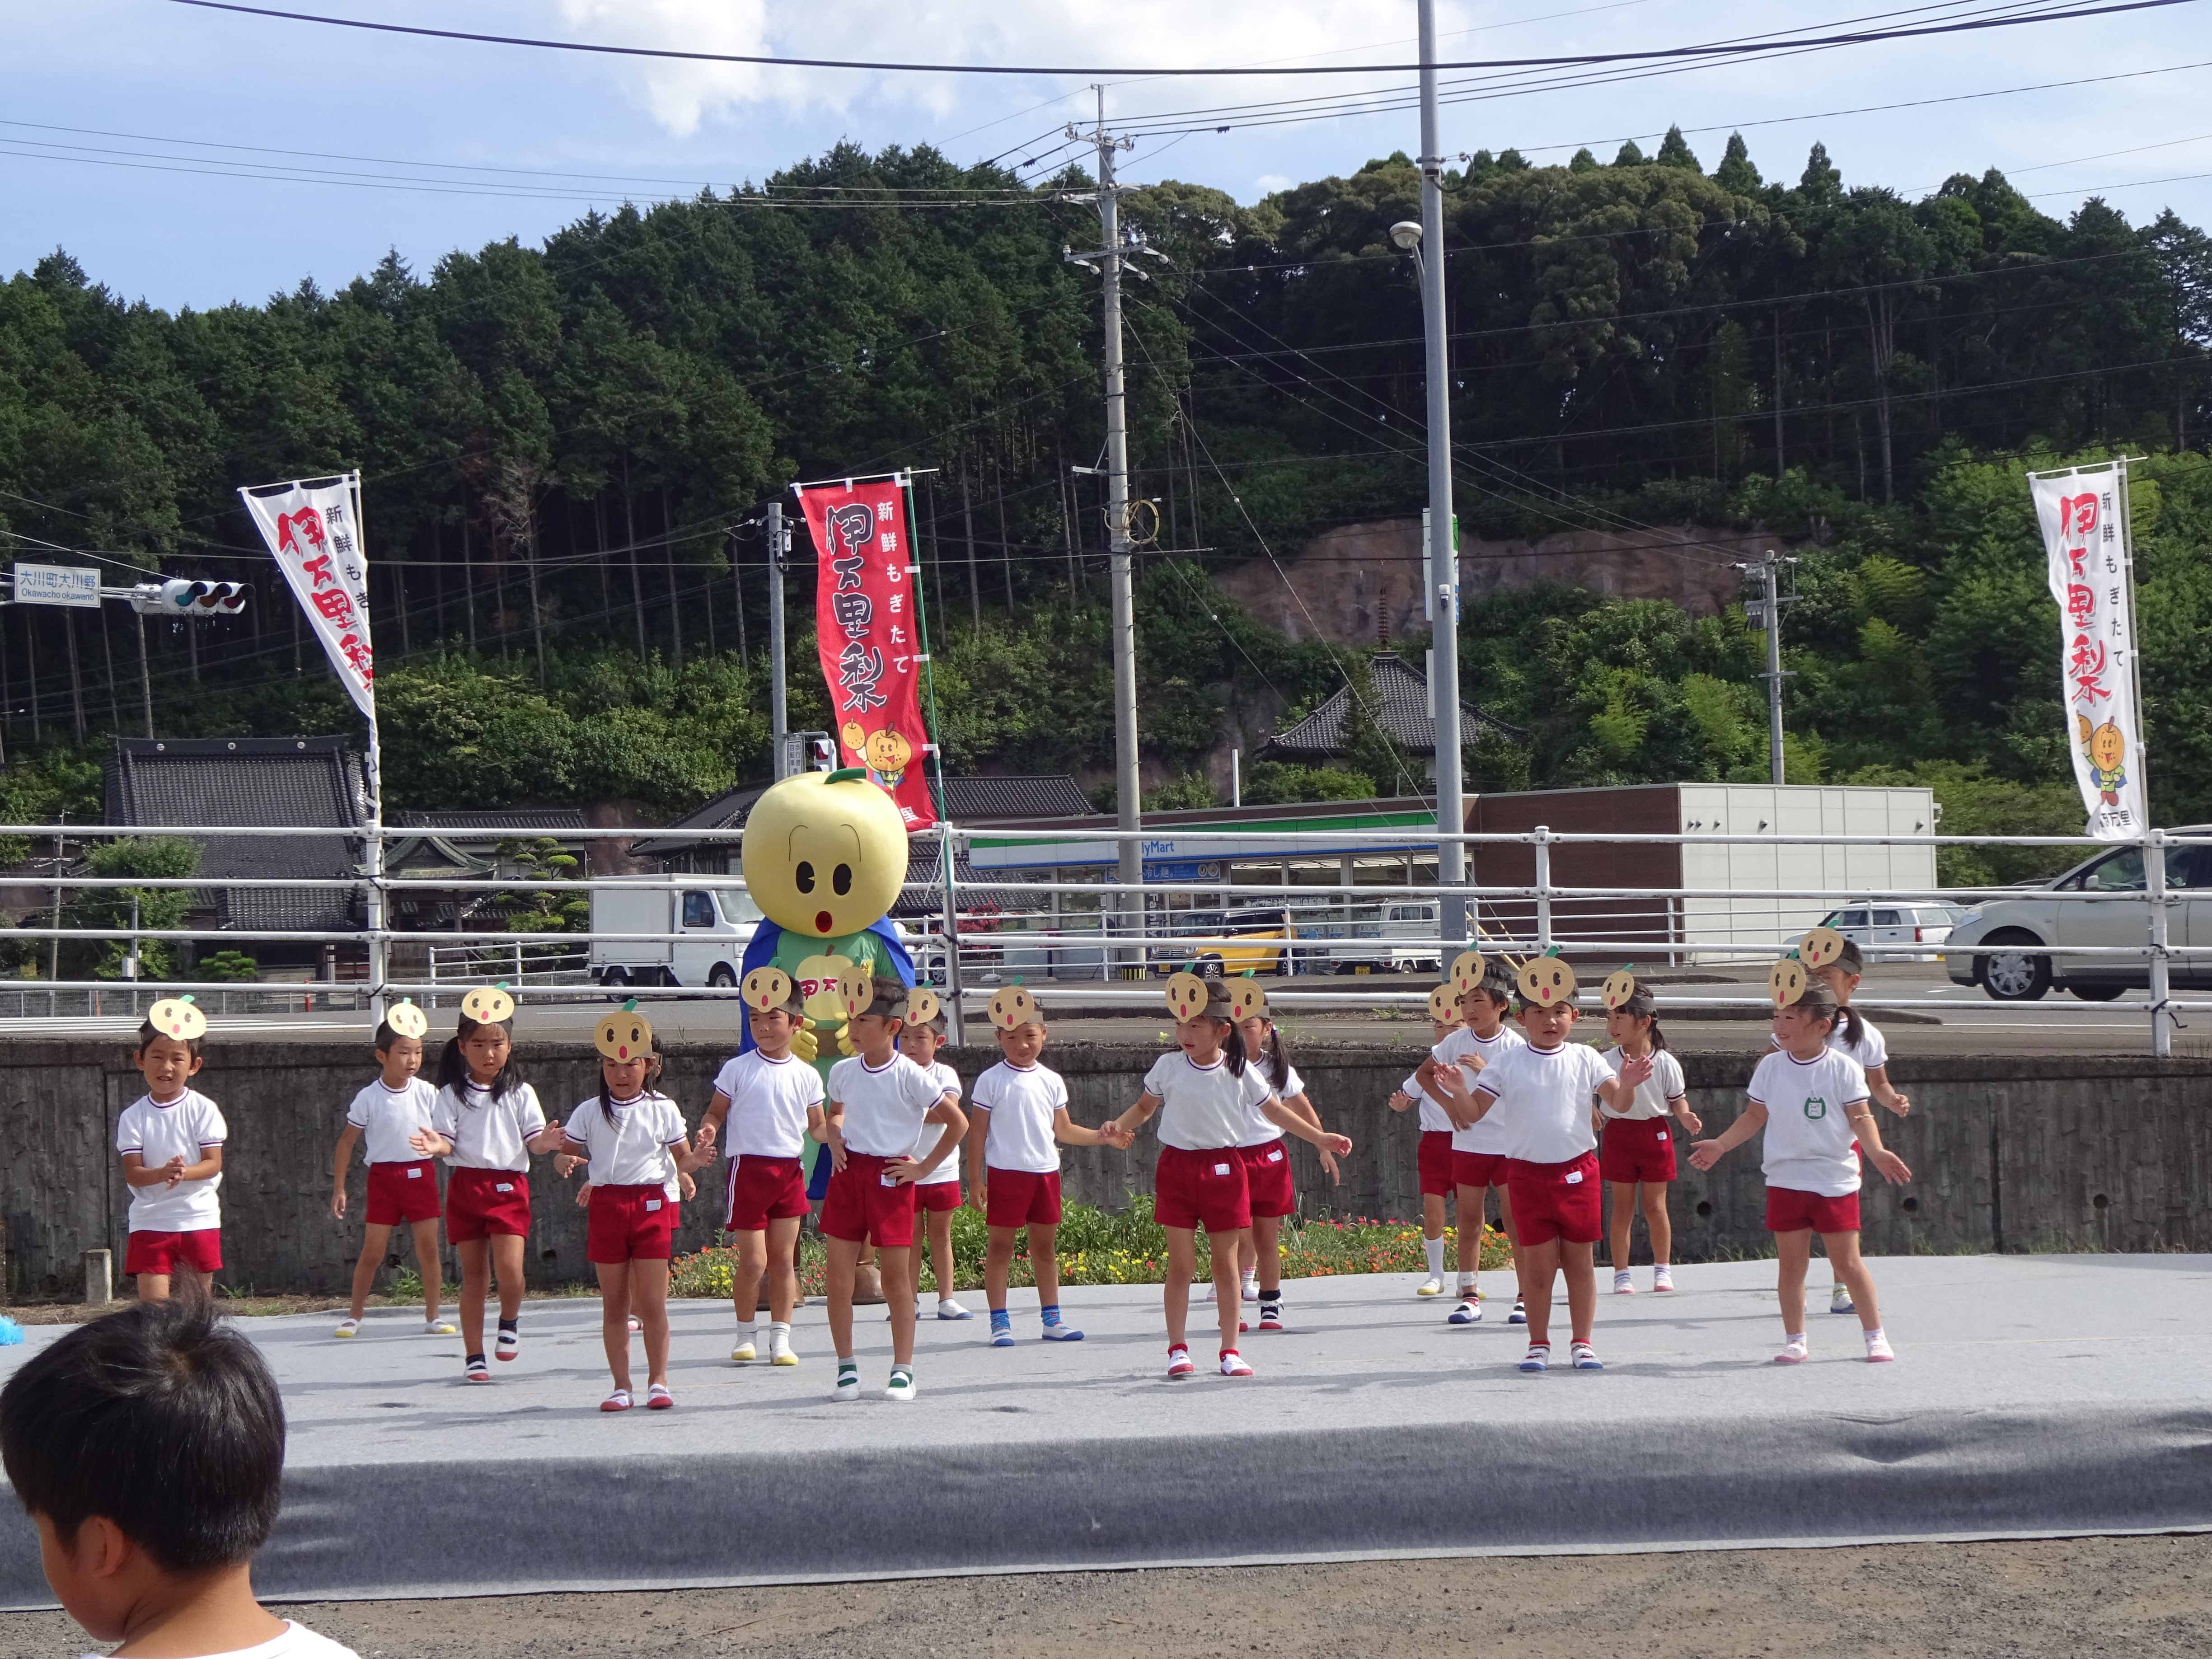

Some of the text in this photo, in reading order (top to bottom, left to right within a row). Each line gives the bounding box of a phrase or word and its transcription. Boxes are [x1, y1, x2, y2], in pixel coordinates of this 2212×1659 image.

[20, 570, 96, 590] 大川町大川野
[22, 588, 94, 600] Okawacho okawano
[826, 503, 887, 713] 伊万里梨
[877, 501, 909, 673] 新鮮もぎたて
[2060, 492, 2113, 705] 伊万里梨
[2101, 492, 2124, 668] 新鮮もぎたて
